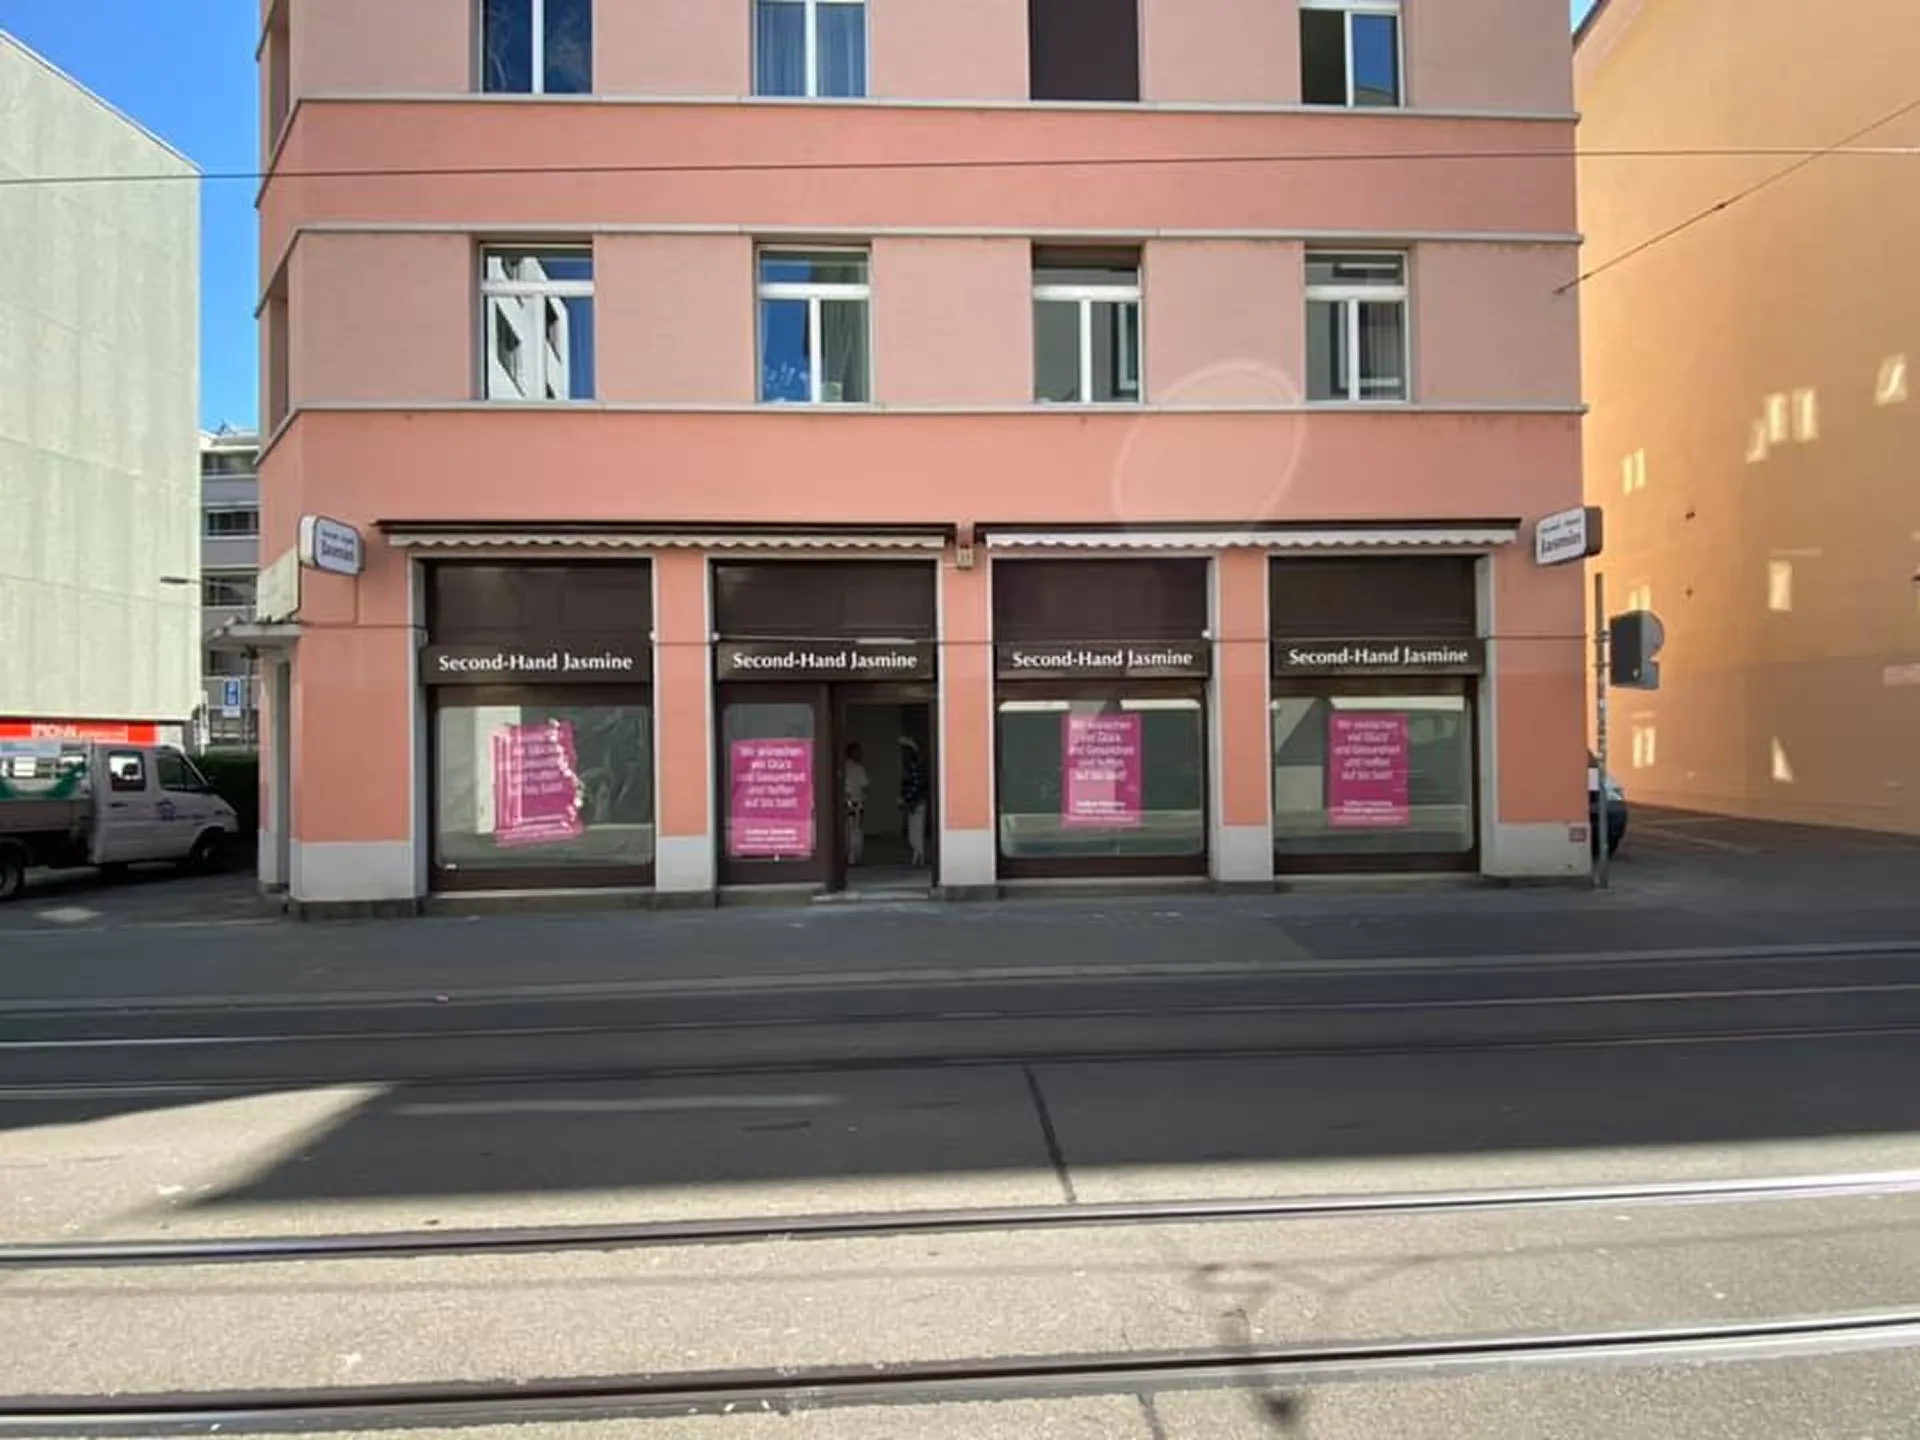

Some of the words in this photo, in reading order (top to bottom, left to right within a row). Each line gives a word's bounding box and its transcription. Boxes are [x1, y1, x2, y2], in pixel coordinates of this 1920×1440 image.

[438, 653, 557, 671] Second-Hand
[563, 653, 633, 670] Jasmine
[732, 652, 846, 668] Second-Hand
[850, 651, 917, 669] Jasmine
[1012, 649, 1122, 667] Second-Hand
[1127, 649, 1193, 667] Jasmine
[1289, 647, 1399, 665] Second-Hand
[1404, 646, 1469, 665] Jasmine
